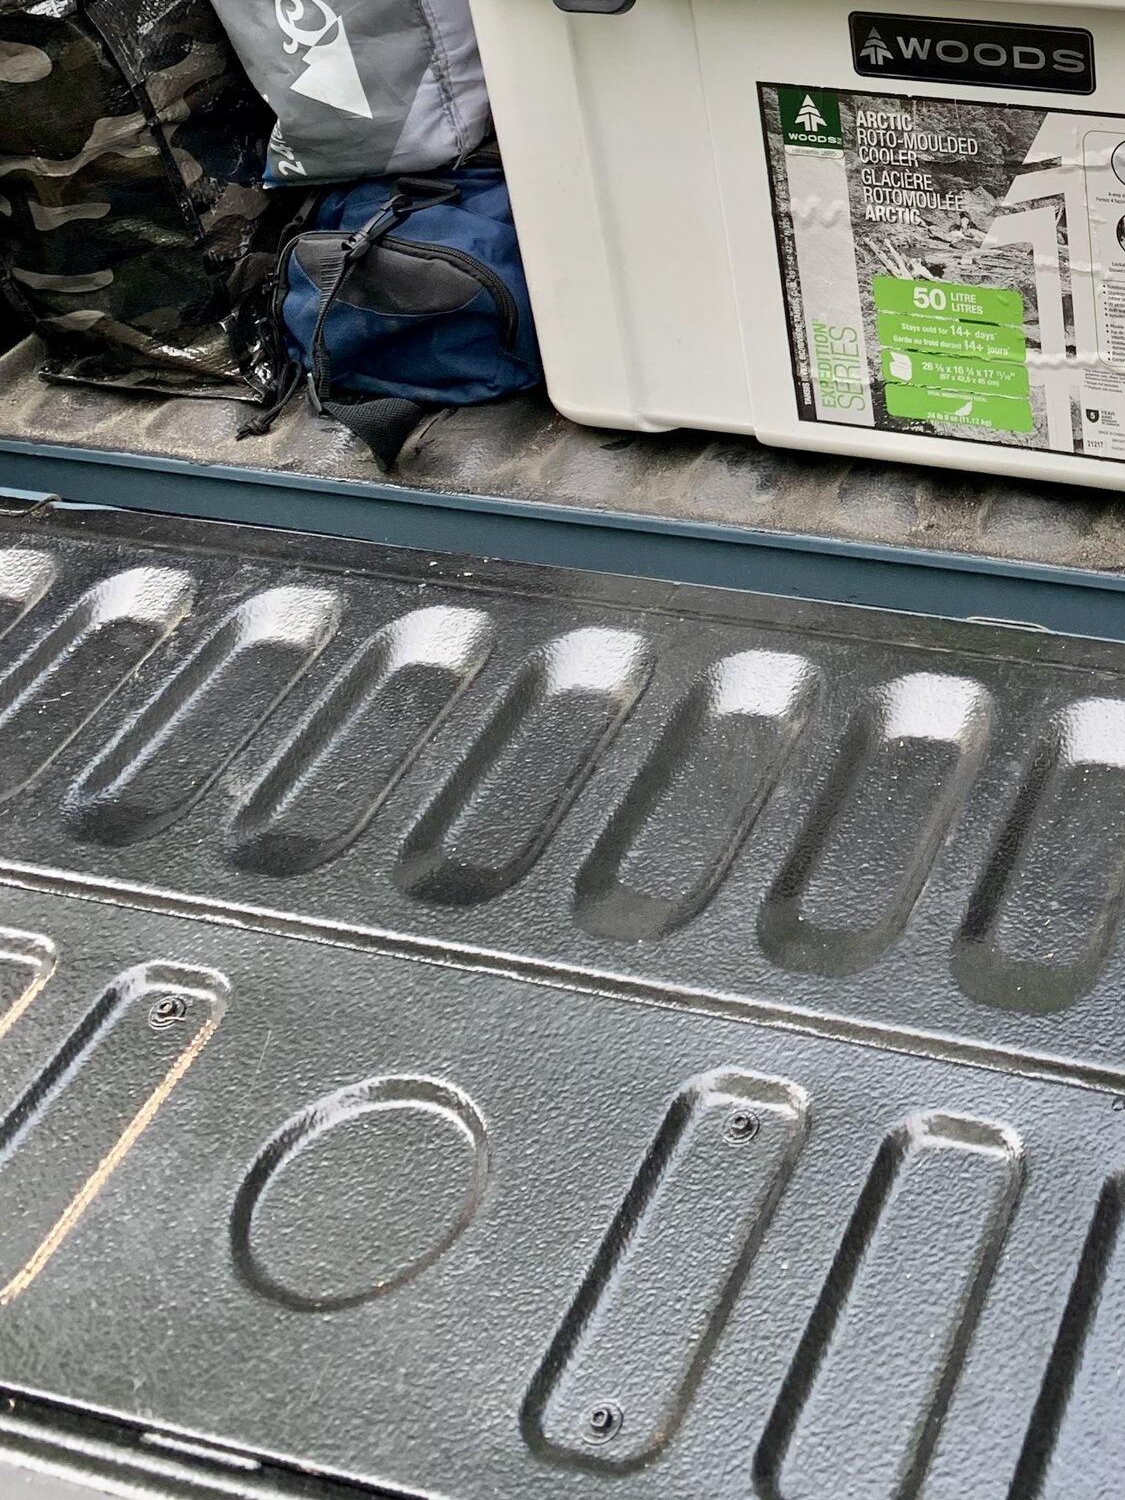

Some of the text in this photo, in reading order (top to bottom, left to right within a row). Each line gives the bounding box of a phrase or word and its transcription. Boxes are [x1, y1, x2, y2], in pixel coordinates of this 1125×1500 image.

[896, 36, 1086, 73] WOODS
[856, 110, 914, 131] ARCTIC
[788, 132, 838, 145] WOODS
[857, 127, 979, 156] ROTO-MOULDED
[858, 145, 920, 168] COOLER
[861, 168, 934, 192] GLACIÈRE
[863, 187, 965, 213] ROTOMOULÉE
[865, 204, 923, 226] ARCTIC
[912, 286, 947, 311] 50
[950, 292, 976, 304] LITRE
[951, 303, 984, 315] LITRES
[901, 322, 920, 333] Stays
[922, 326, 937, 334] cold
[950, 325, 971, 338] 14+
[963, 340, 984, 352] 14+
[812, 323, 837, 408] EXPEDITION
[828, 326, 866, 410] SERIES
[1089, 411, 1096, 420] 5
